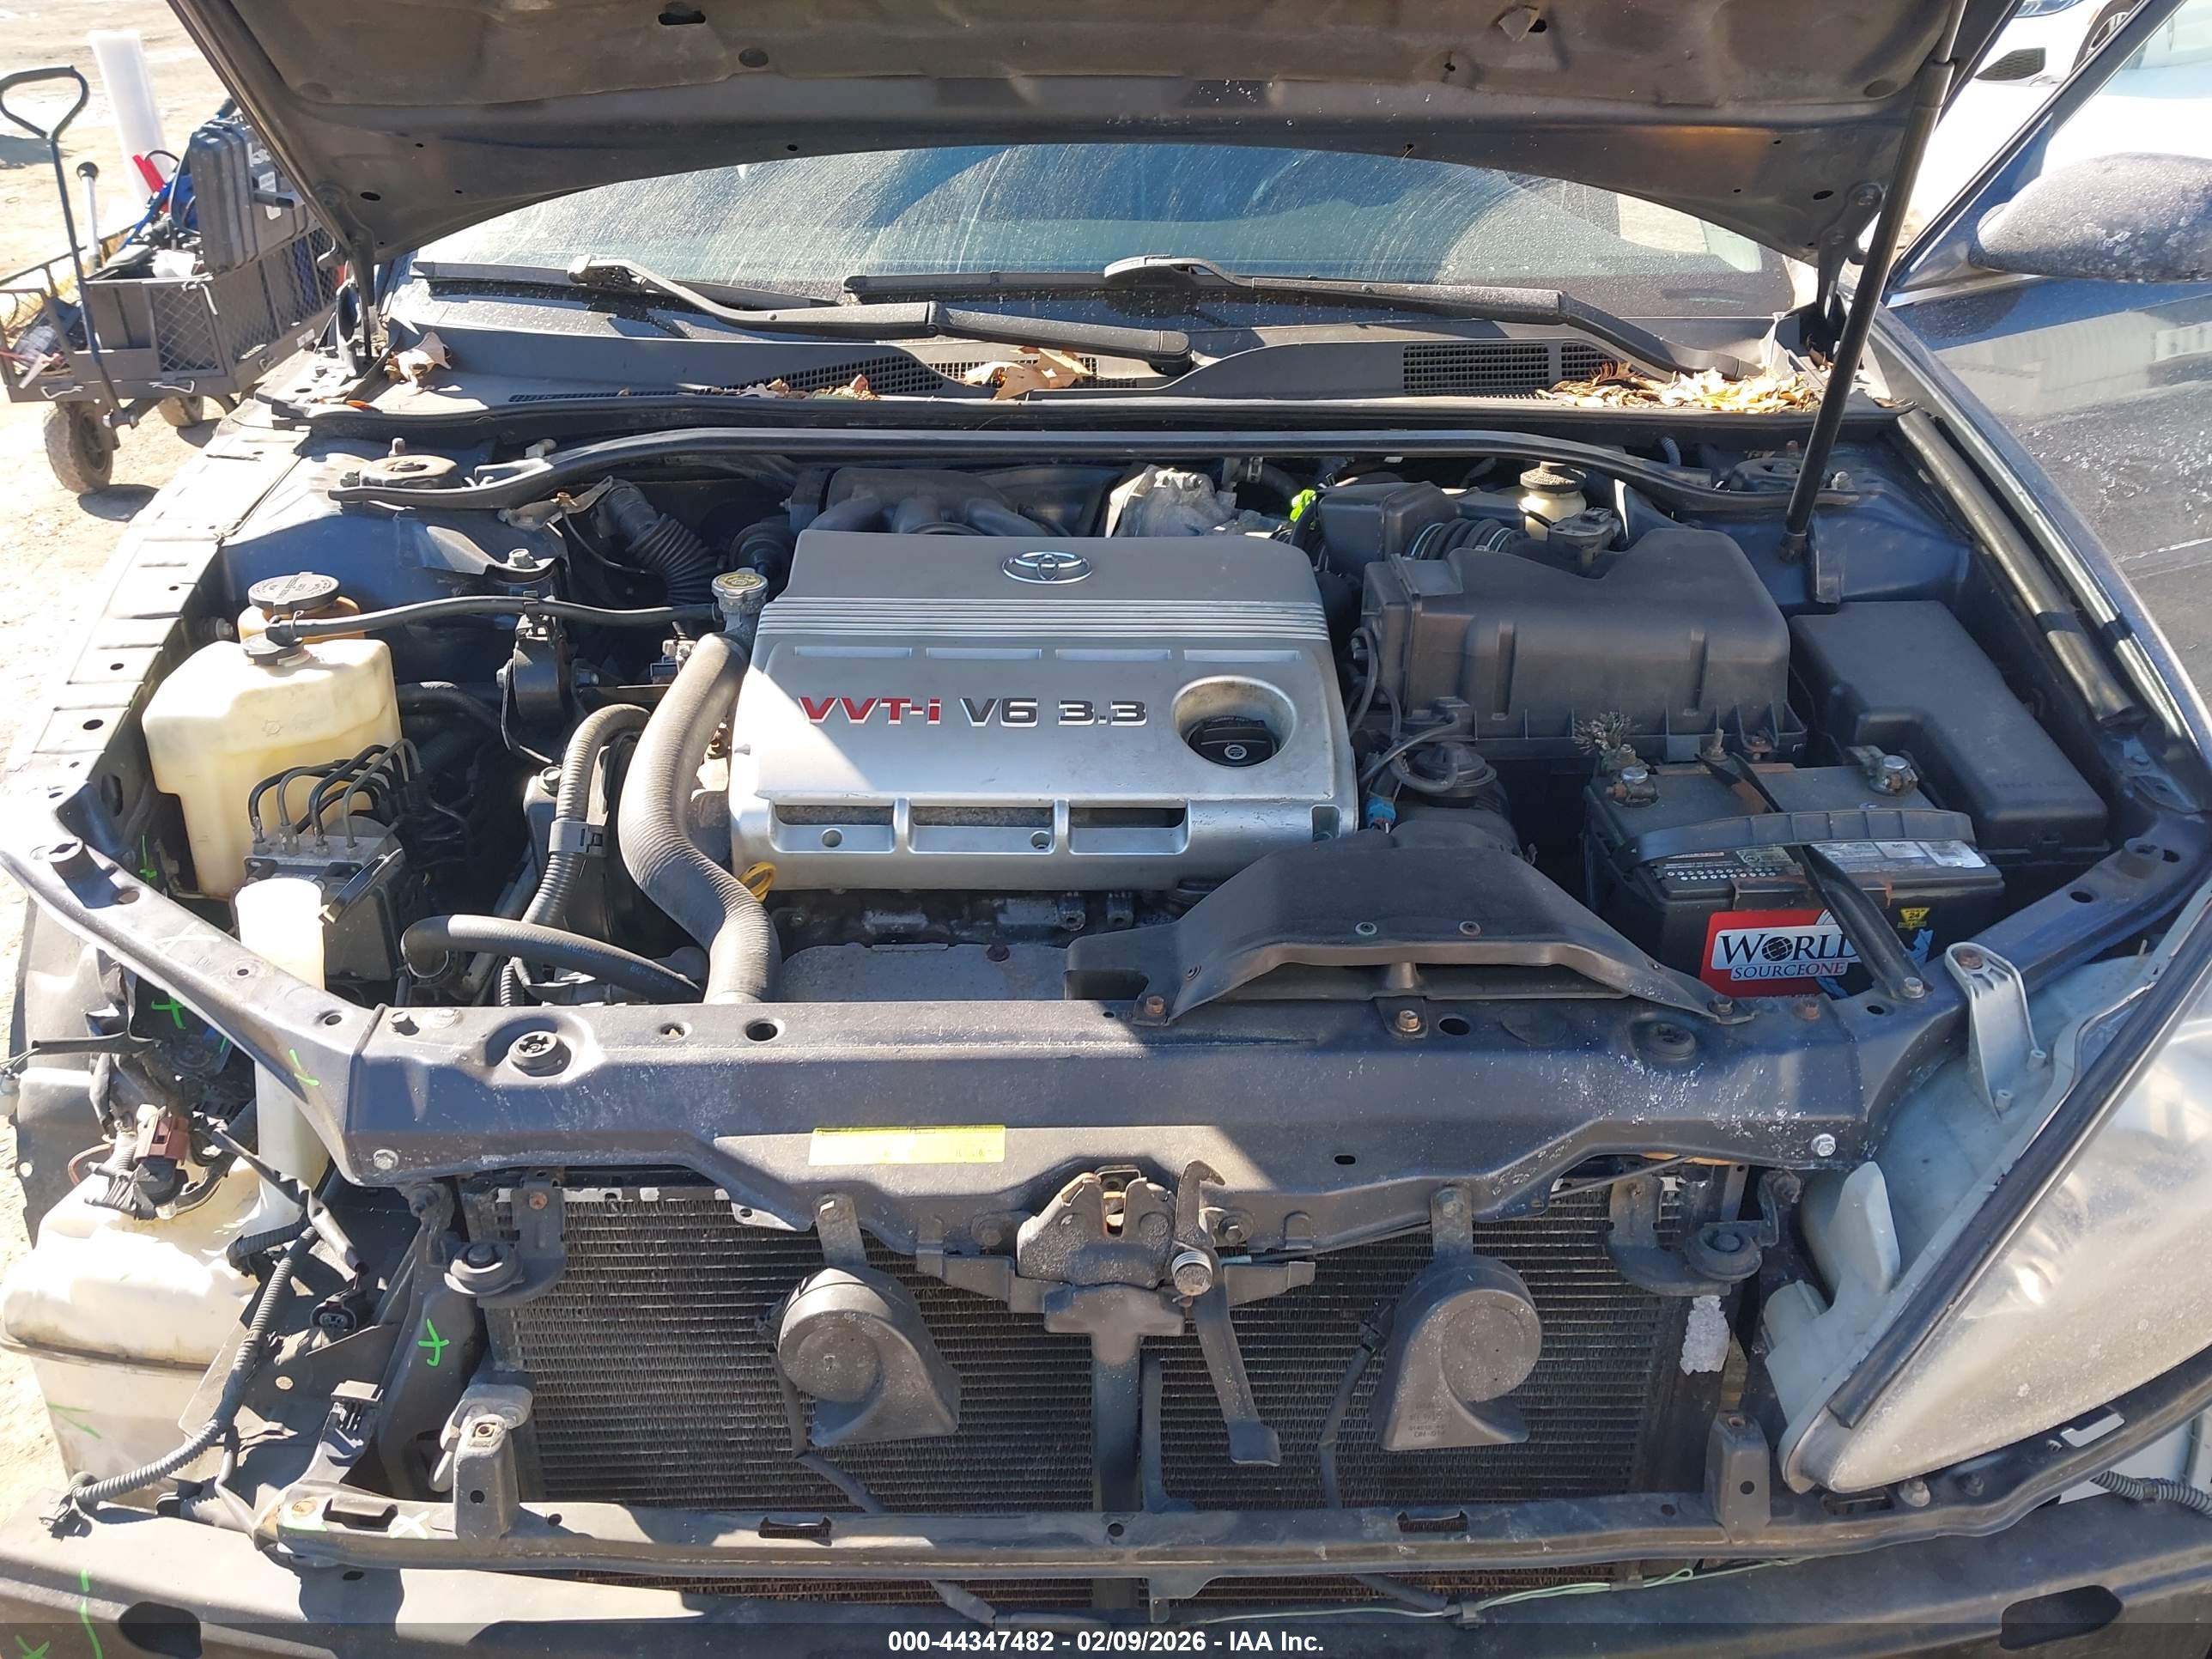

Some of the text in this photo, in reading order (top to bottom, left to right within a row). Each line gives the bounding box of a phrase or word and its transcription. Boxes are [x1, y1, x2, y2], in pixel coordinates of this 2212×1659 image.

[798, 697, 1147, 727] VVT-i V6 3.3
